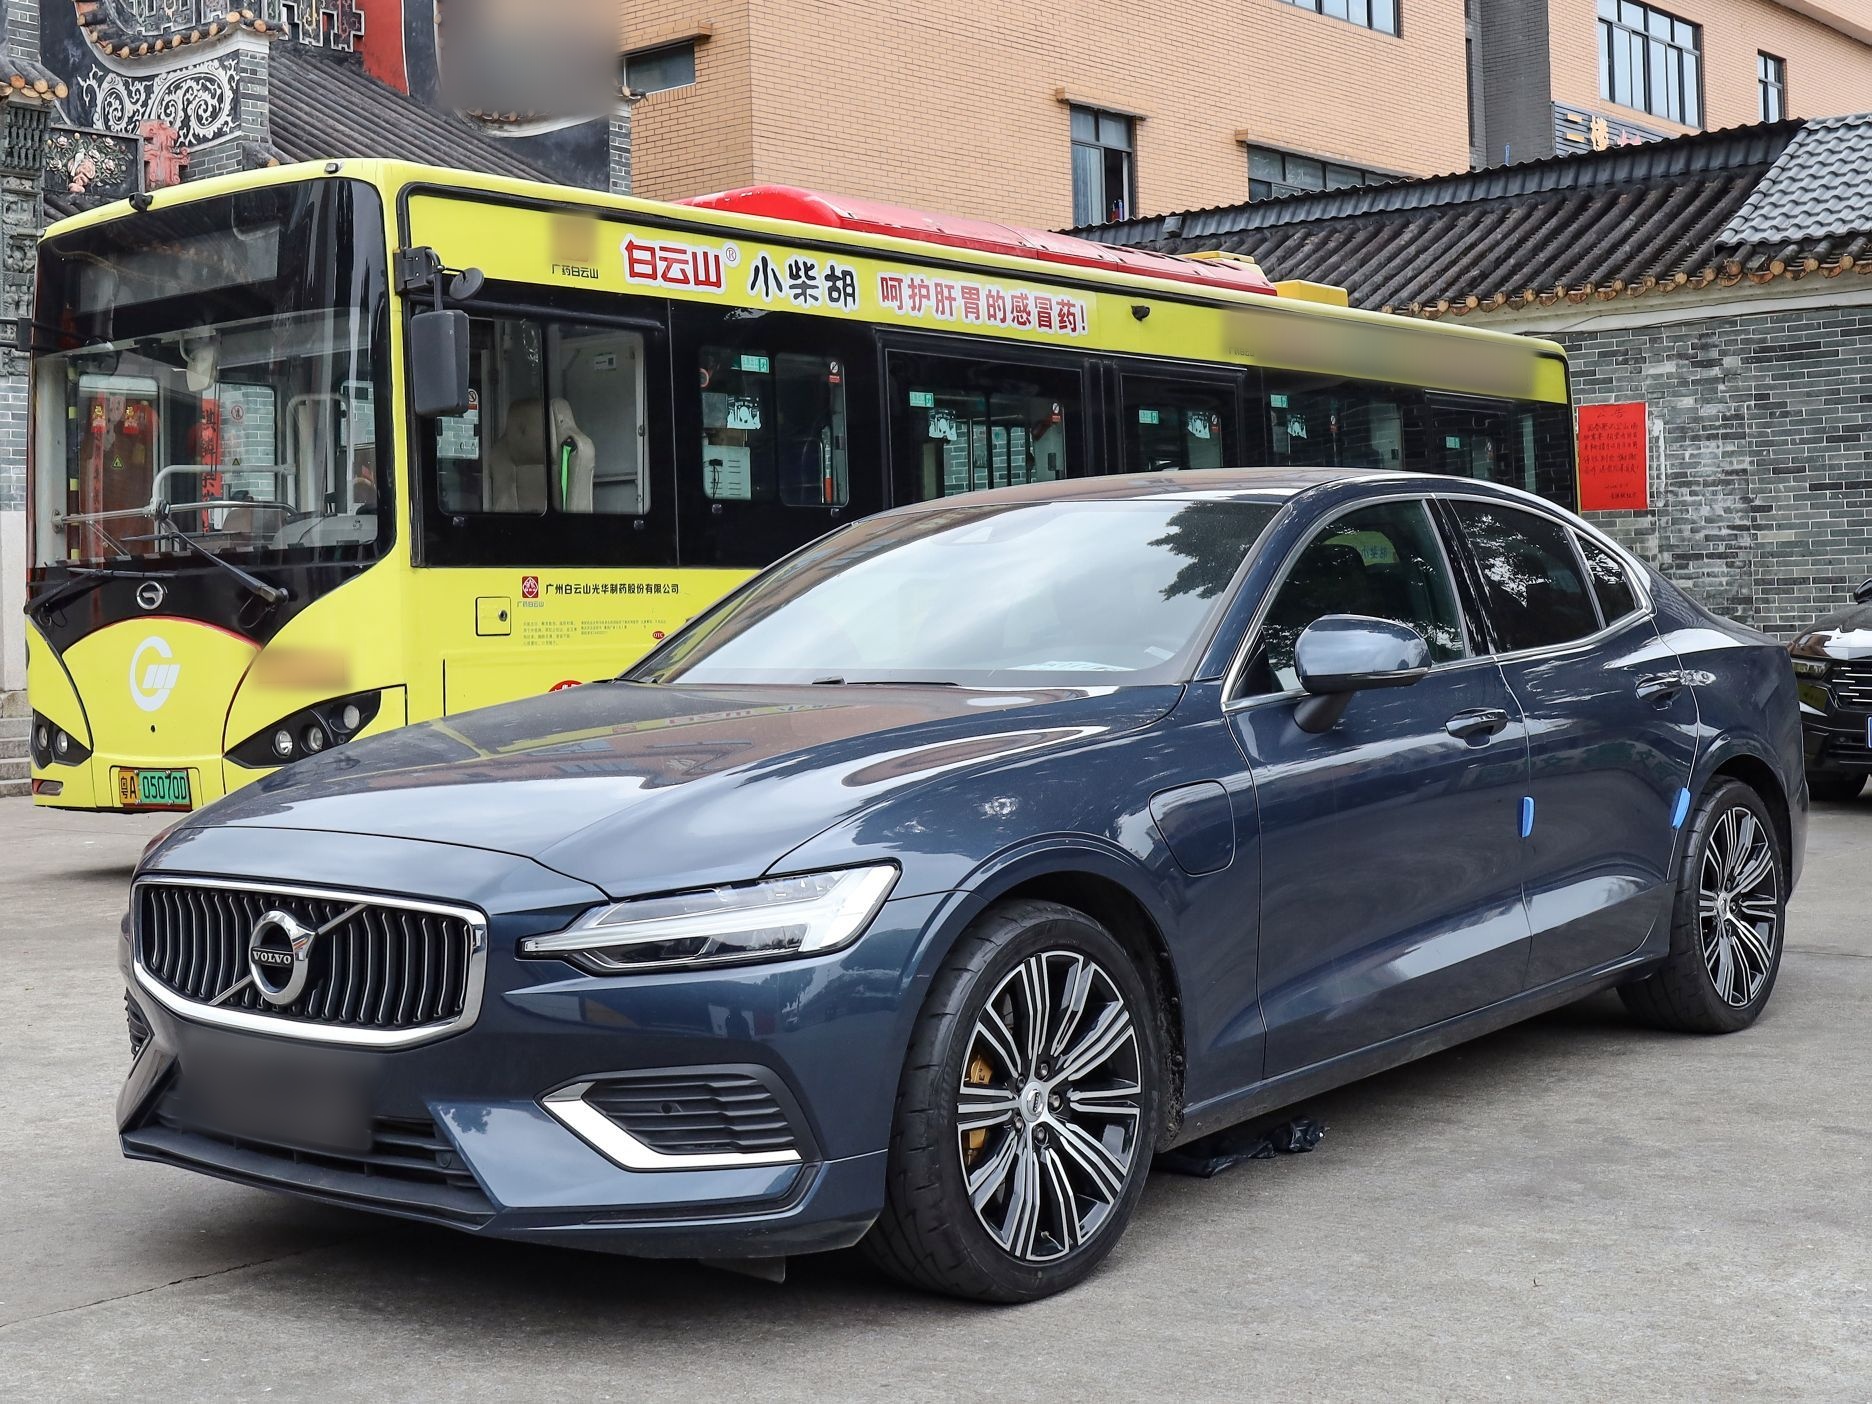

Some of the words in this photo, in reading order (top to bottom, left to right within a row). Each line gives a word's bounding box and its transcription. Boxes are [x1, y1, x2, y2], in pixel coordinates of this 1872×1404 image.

[552, 263, 599, 279] 广药白云山
[625, 239, 722, 289] 白云山
[750, 255, 856, 307] 小柴胡
[880, 276, 1086, 333] 呵护肝胃的感冒药!
[545, 583, 679, 595] 广州白云山光华制药股份有限公司
[252, 951, 292, 964] VOLVO
